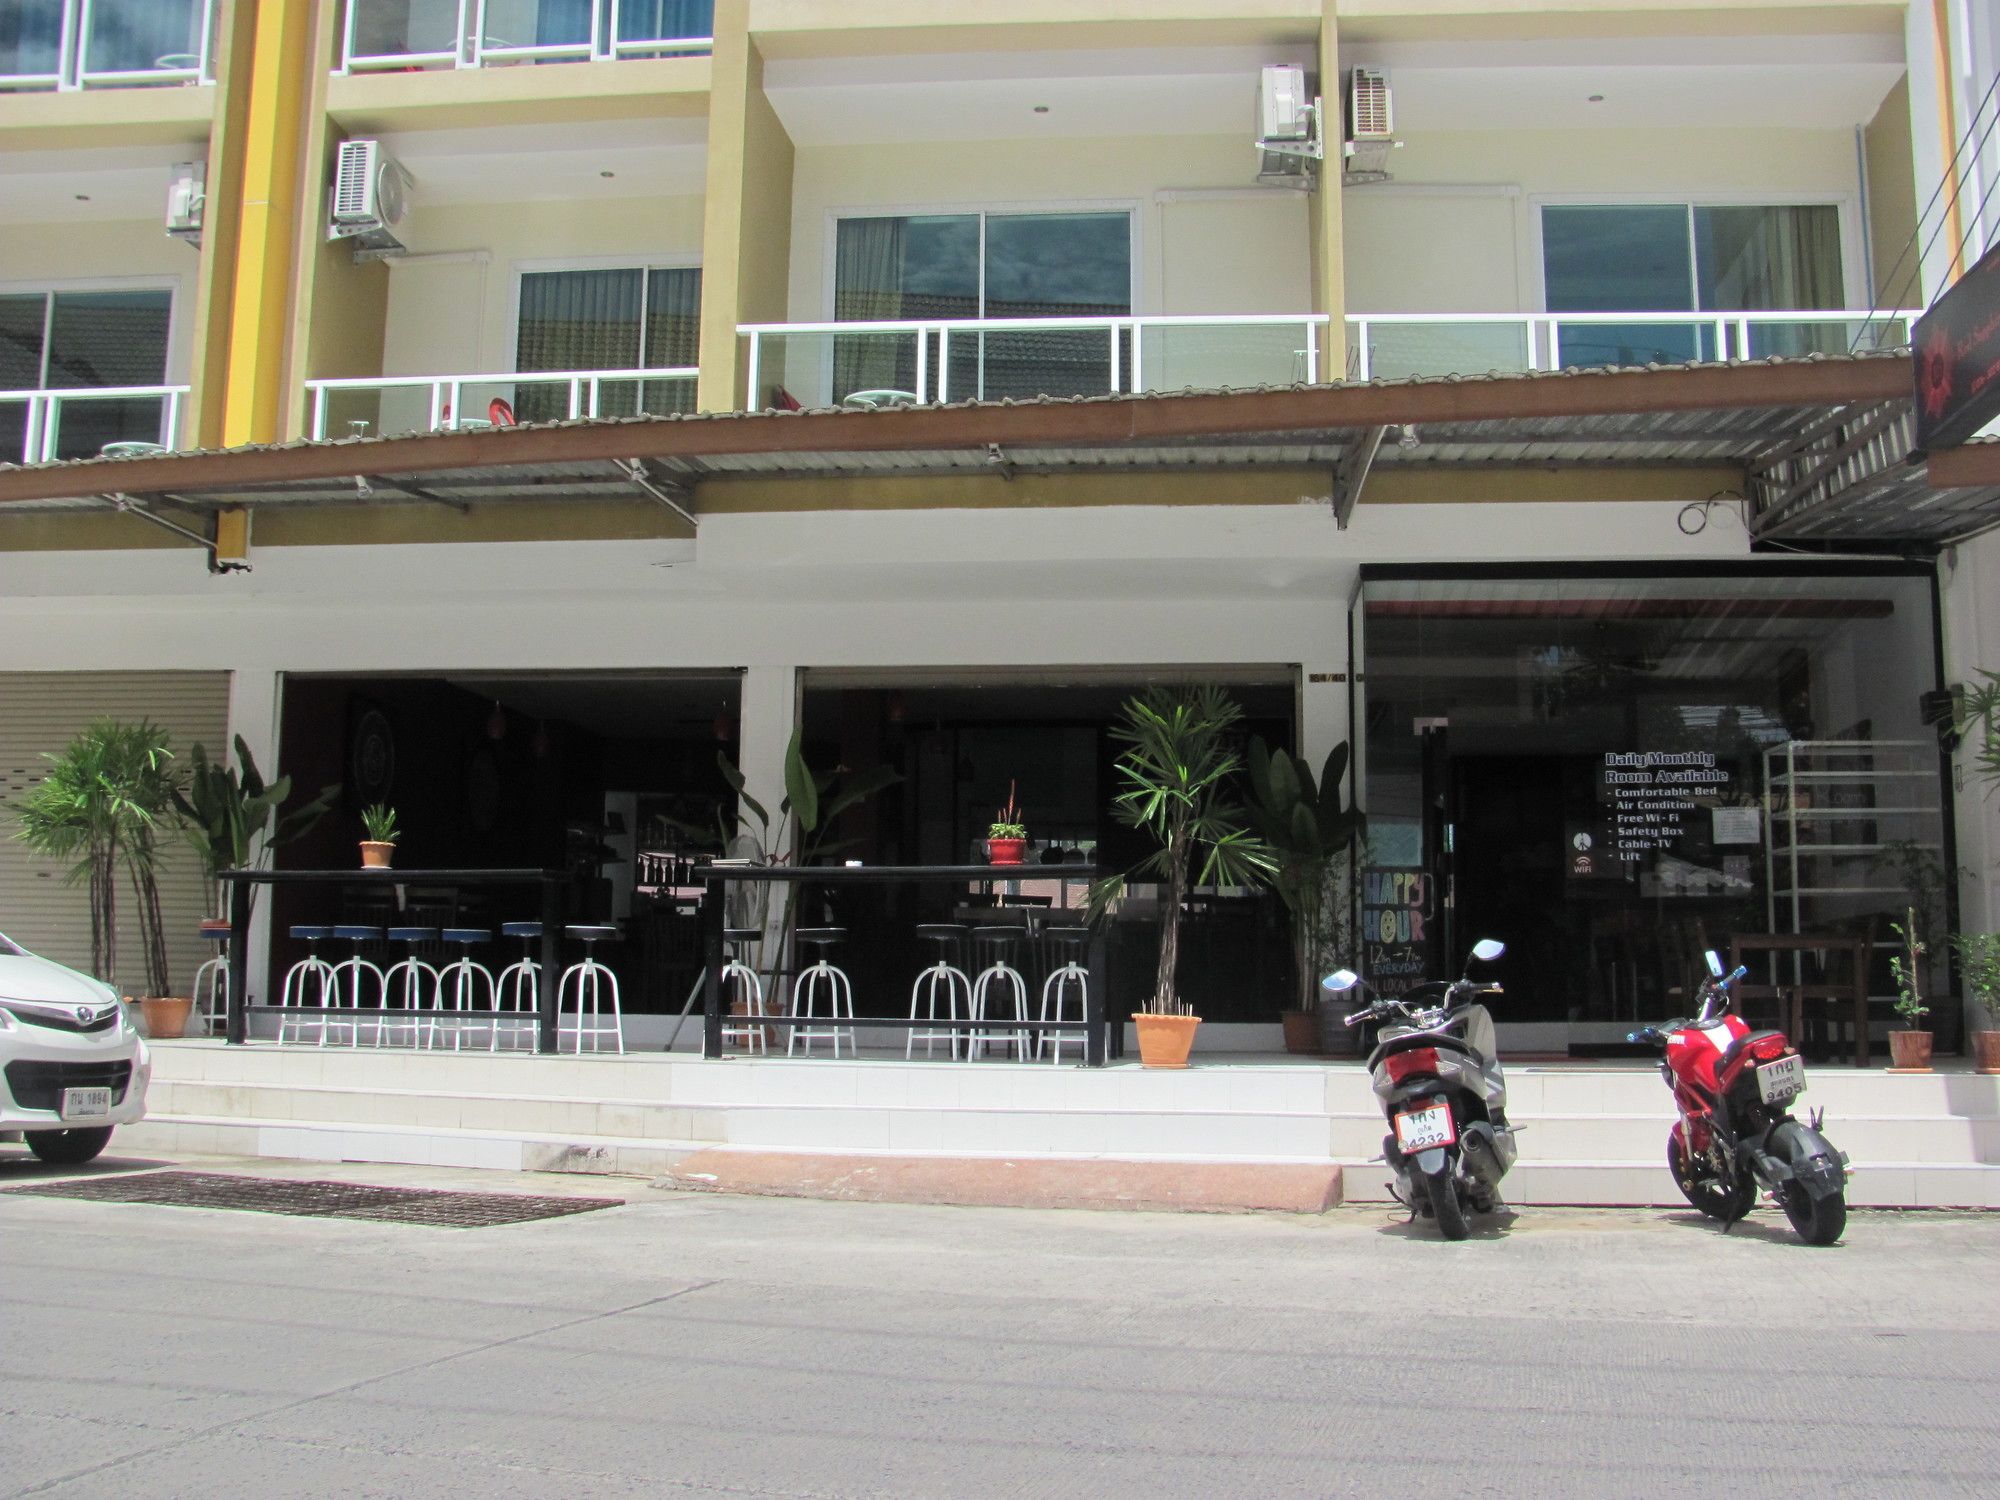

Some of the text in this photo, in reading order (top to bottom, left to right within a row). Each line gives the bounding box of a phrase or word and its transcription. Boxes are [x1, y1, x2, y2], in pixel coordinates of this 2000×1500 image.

[1606, 752, 1715, 768] Daily/Monthly
[1605, 769, 1729, 783] Room Available
[1615, 786, 1717, 797] Comfortable Bed
[1616, 800, 1695, 810] Air Condition
[1617, 813, 1643, 823] Free
[1618, 826, 1684, 837] Safety Box
[1620, 852, 1641, 861] Lift
[1364, 872, 1425, 907] HAPPY
[1363, 910, 1425, 944] HOUR
[1373, 962, 1425, 975] EVERYDAY
[1767, 1082, 1802, 1101] 9405
[1409, 1132, 1445, 1147] 4232
